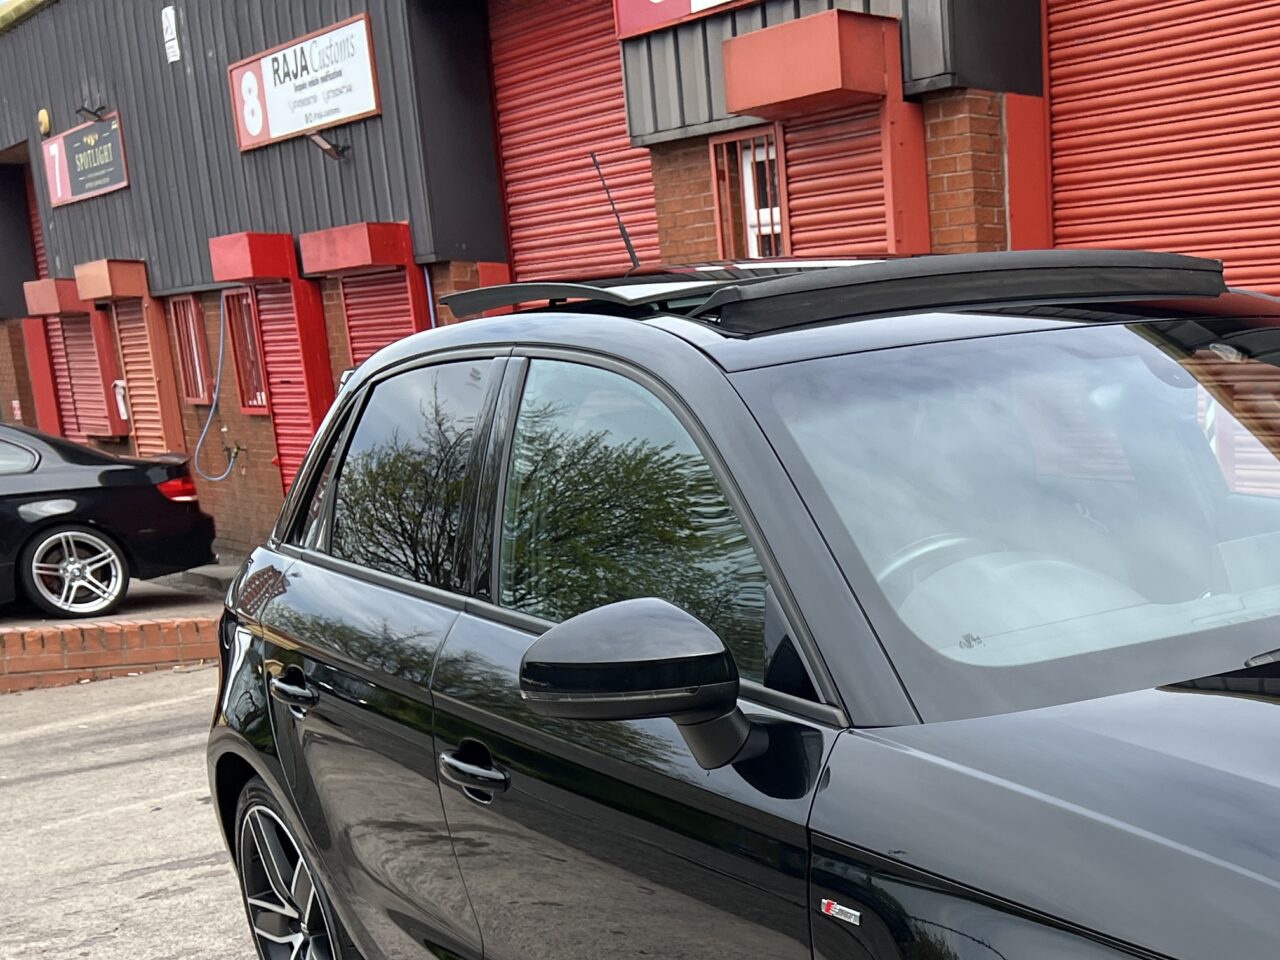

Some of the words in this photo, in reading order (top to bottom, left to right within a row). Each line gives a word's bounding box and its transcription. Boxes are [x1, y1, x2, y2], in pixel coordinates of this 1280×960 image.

[271, 47, 310, 87] RAJA
[309, 34, 356, 73] Customs
[241, 71, 263, 136] 8
[75, 143, 113, 172] SPOTLIGHT
